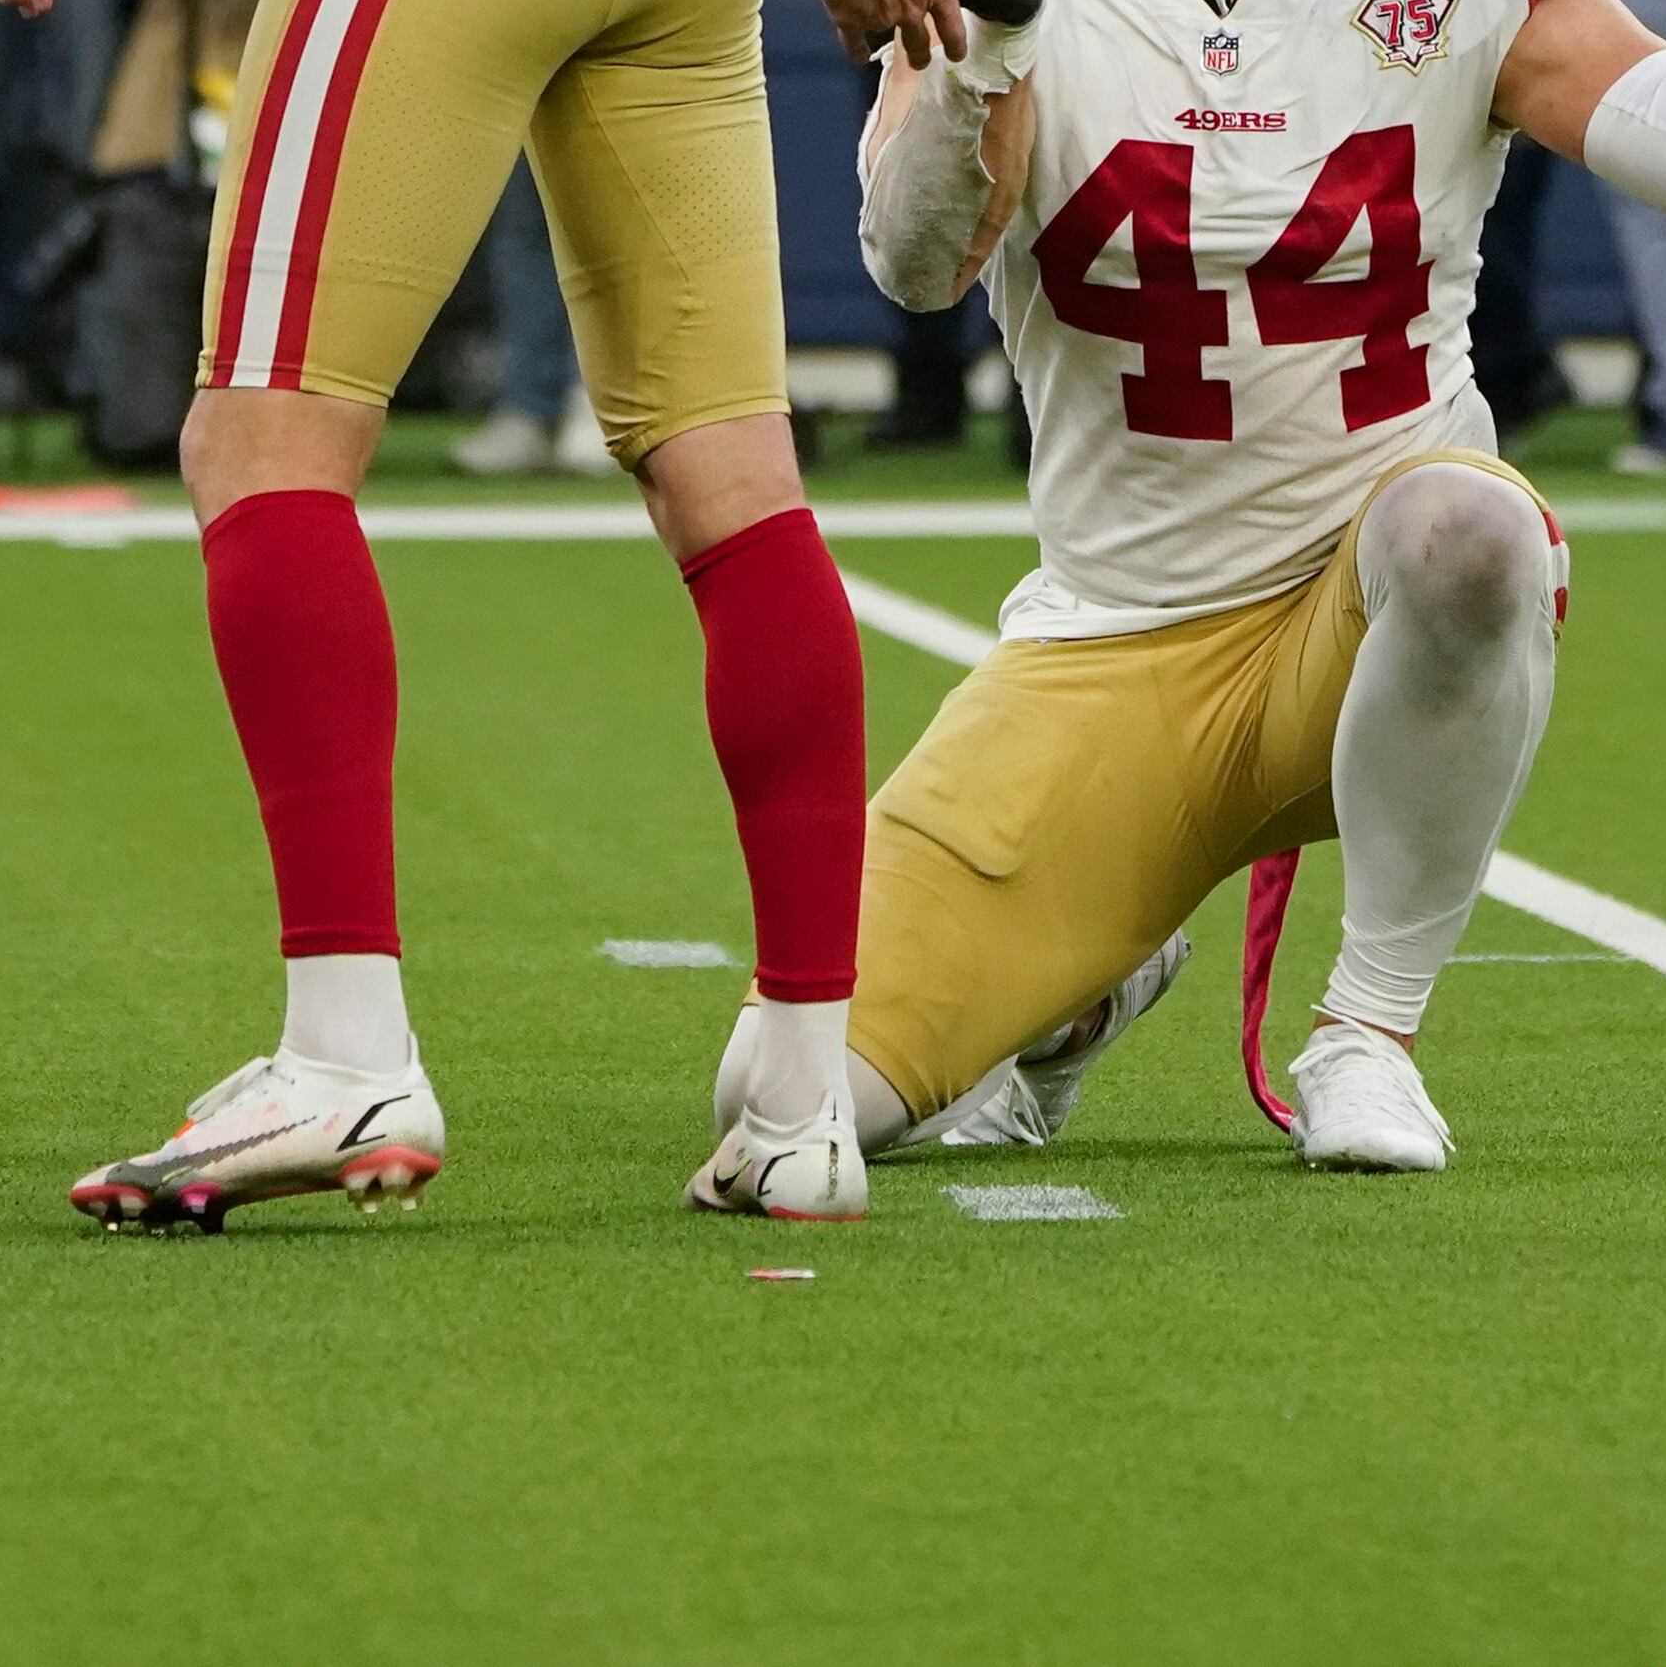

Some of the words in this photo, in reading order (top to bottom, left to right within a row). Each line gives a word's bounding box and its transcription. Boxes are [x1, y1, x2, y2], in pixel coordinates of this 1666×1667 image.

[1206, 50, 1235, 71] NFL
[1174, 108, 1287, 132] 49ERS
[1030, 123, 1435, 441] 44
